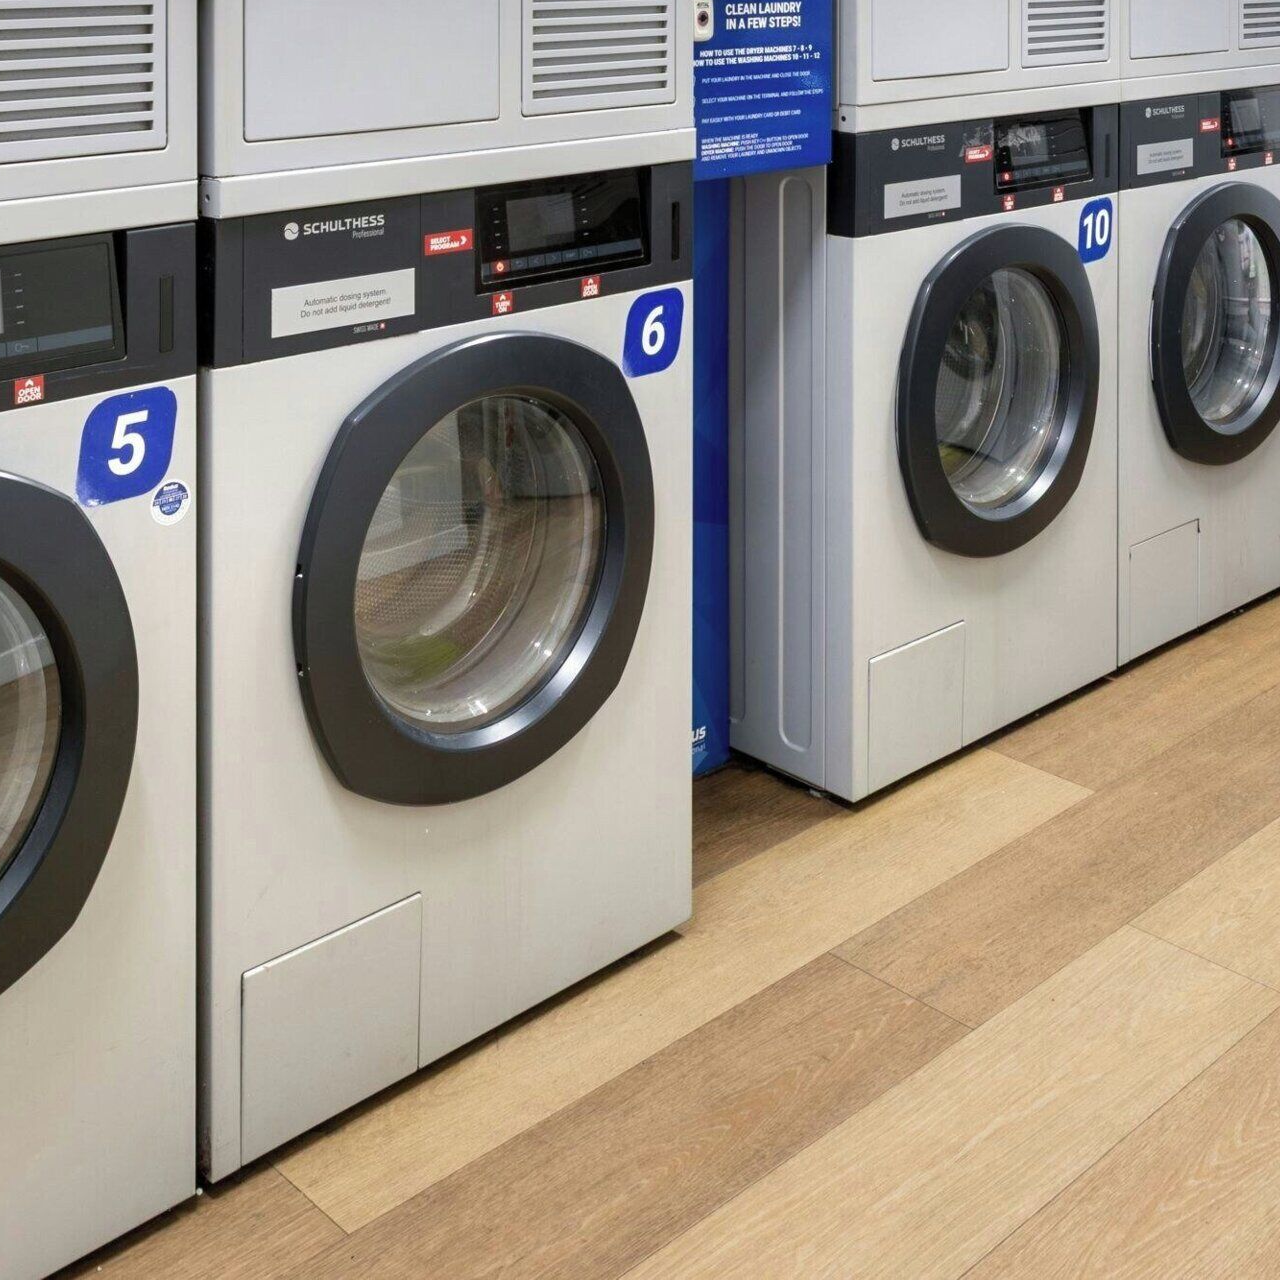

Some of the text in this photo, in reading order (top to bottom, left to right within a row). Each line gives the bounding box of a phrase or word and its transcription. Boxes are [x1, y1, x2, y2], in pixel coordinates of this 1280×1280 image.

[726, 2, 801, 15] CLEAN LAUNDRY
[726, 16, 801, 29] IN A FEW STEPS!
[738, 56, 763, 64] WASHING
[764, 54, 791, 62] MACHINES
[1153, 105, 1184, 116] SCHULTHESS
[901, 135, 945, 148] SCHULTHESS
[304, 215, 385, 236] SCHULTHESS
[1083, 209, 1109, 249] 10
[353, 228, 384, 239] Professional
[430, 242, 459, 251] PROGRAM
[431, 237, 450, 245] SELECT
[304, 297, 337, 307] Automatic
[339, 293, 361, 303] dosing
[496, 300, 510, 308] TURN
[301, 298, 391, 318] Do not add liquid detergent!
[642, 305, 665, 356] 6
[18, 387, 40, 396] OPEN
[18, 393, 41, 403] DOOR
[108, 410, 152, 477] 5
